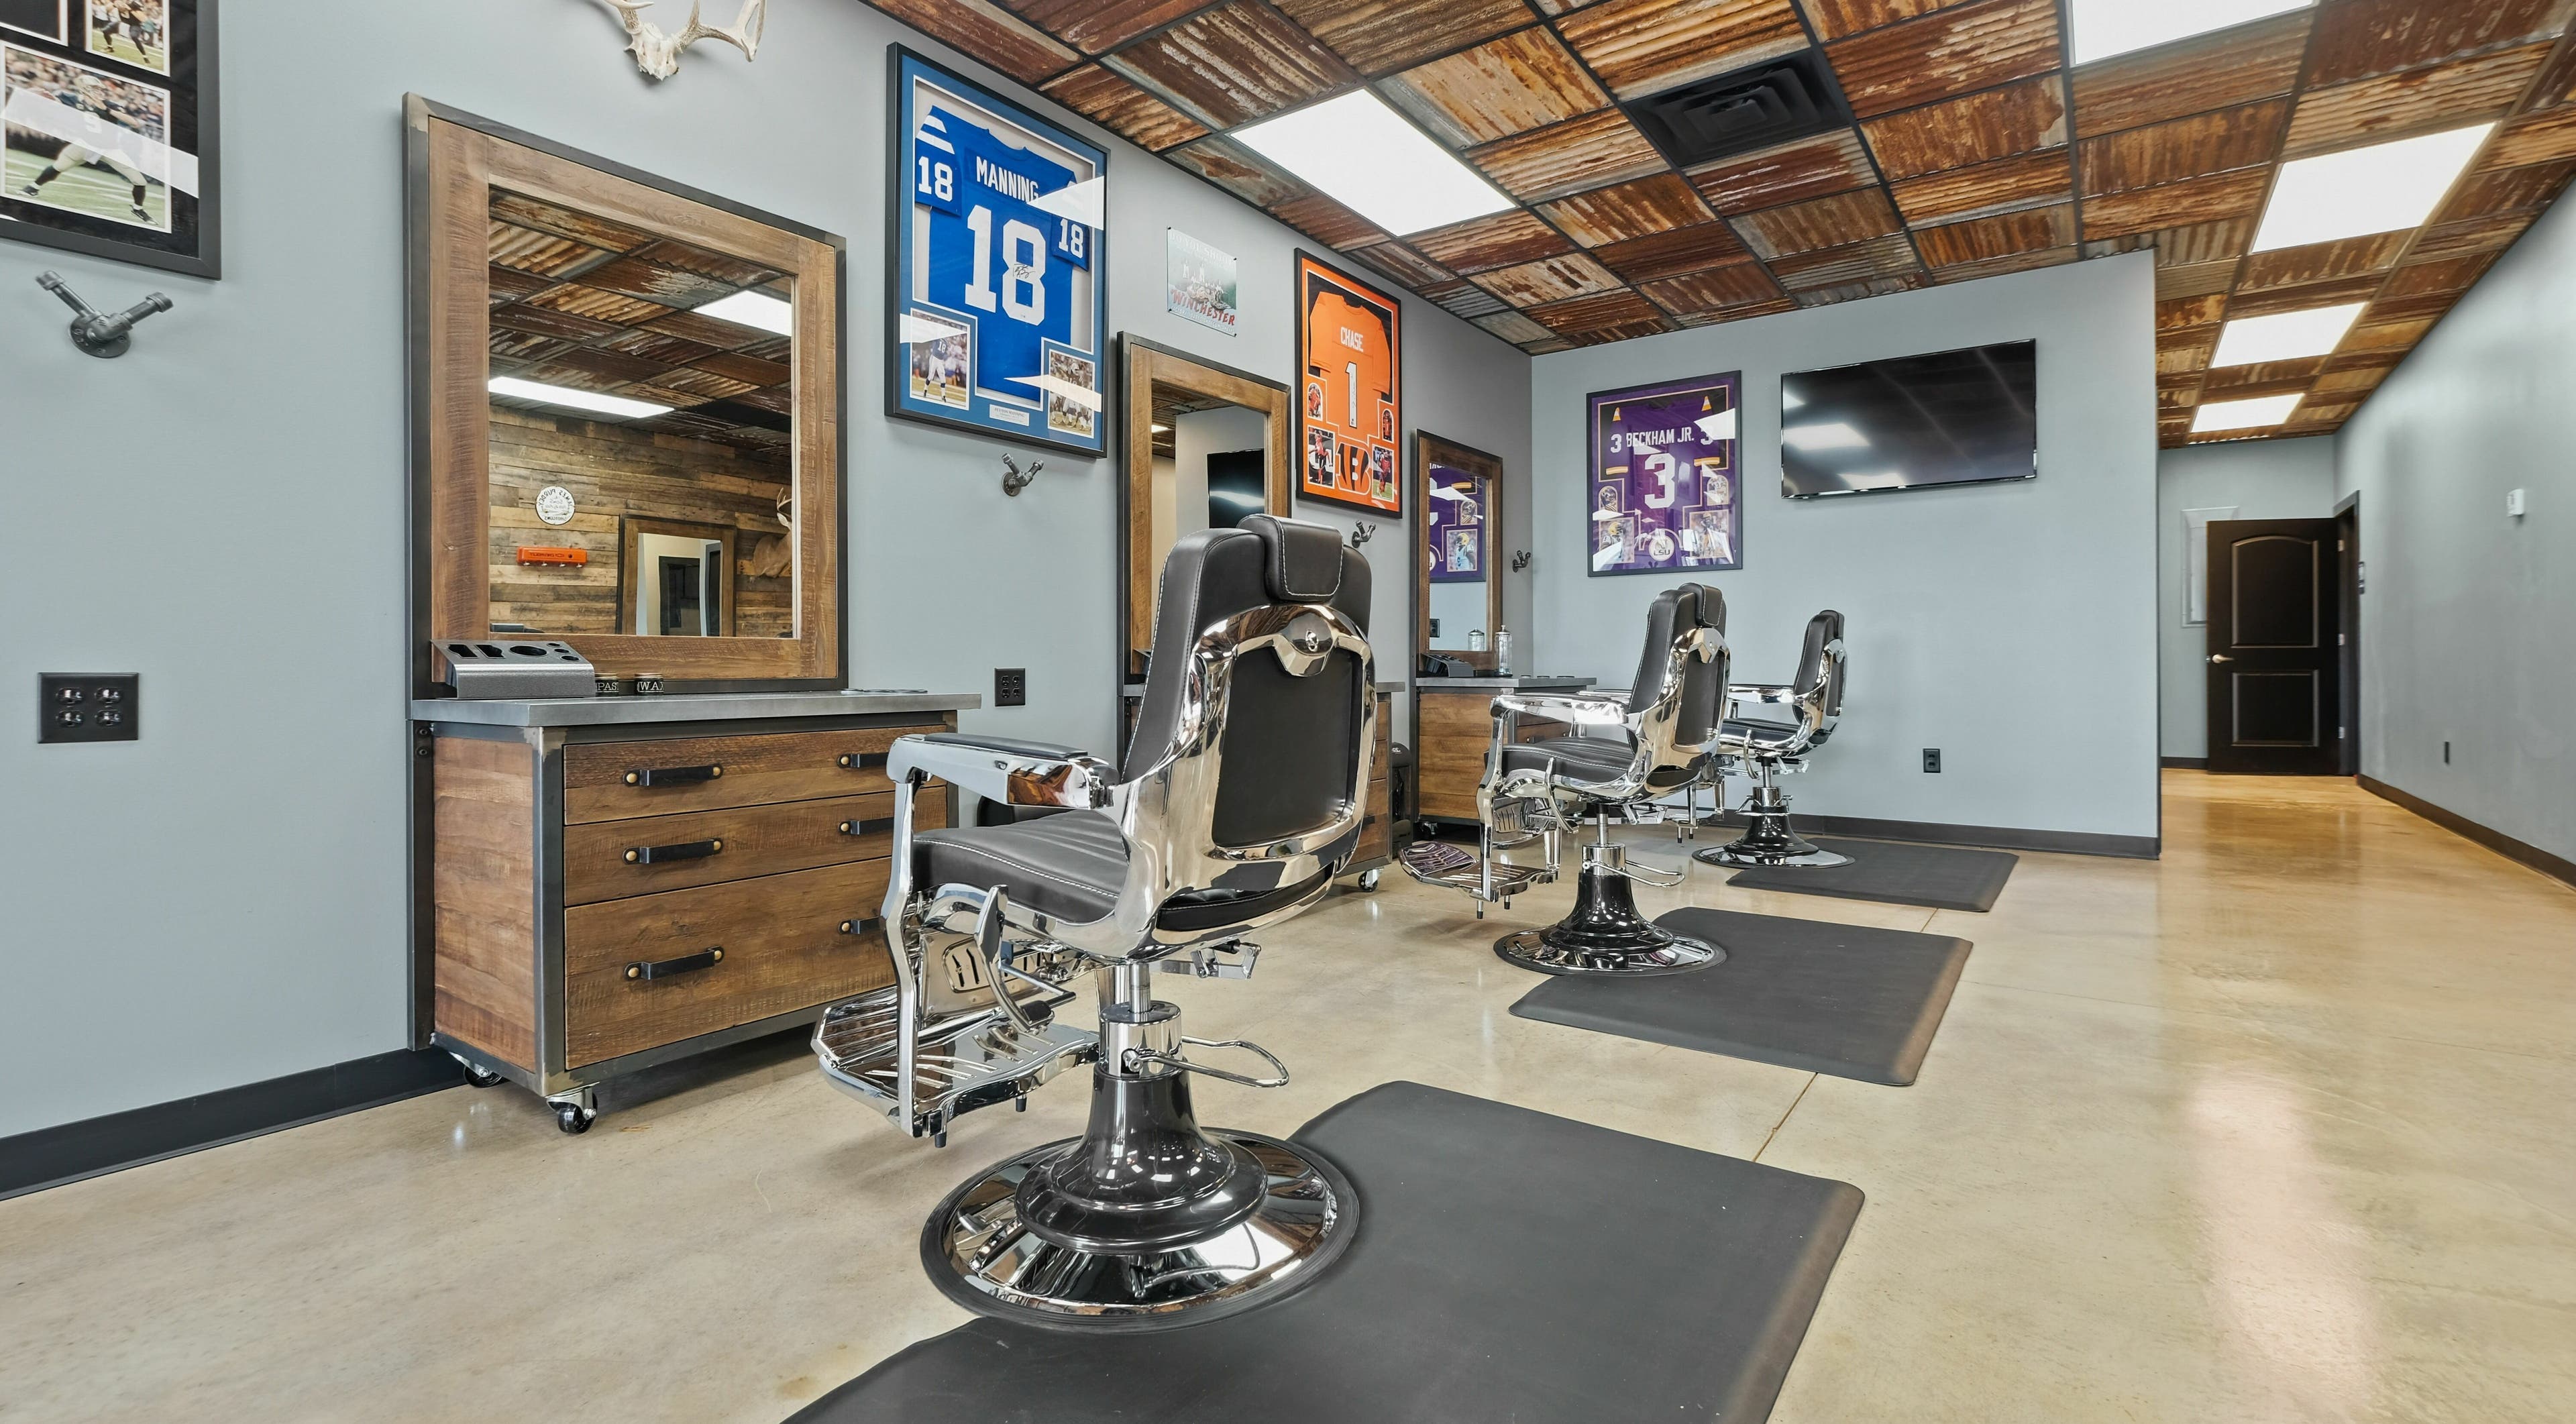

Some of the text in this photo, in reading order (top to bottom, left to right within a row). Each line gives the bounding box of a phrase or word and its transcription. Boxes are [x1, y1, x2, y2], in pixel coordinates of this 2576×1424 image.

[918, 156, 953, 201] 18
[976, 156, 1039, 203] MANNING
[1058, 217, 1084, 259] 18
[964, 205, 1046, 326] 18
[1171, 288, 1235, 326] WINCHESTER
[938, 341, 947, 353] 18
[1340, 326, 1364, 352] CHASE
[1345, 361, 1358, 429] 1
[1610, 433, 1622, 453] 3
[1626, 427, 1695, 448] BECKHAM JR.
[1645, 453, 1676, 509] 3
